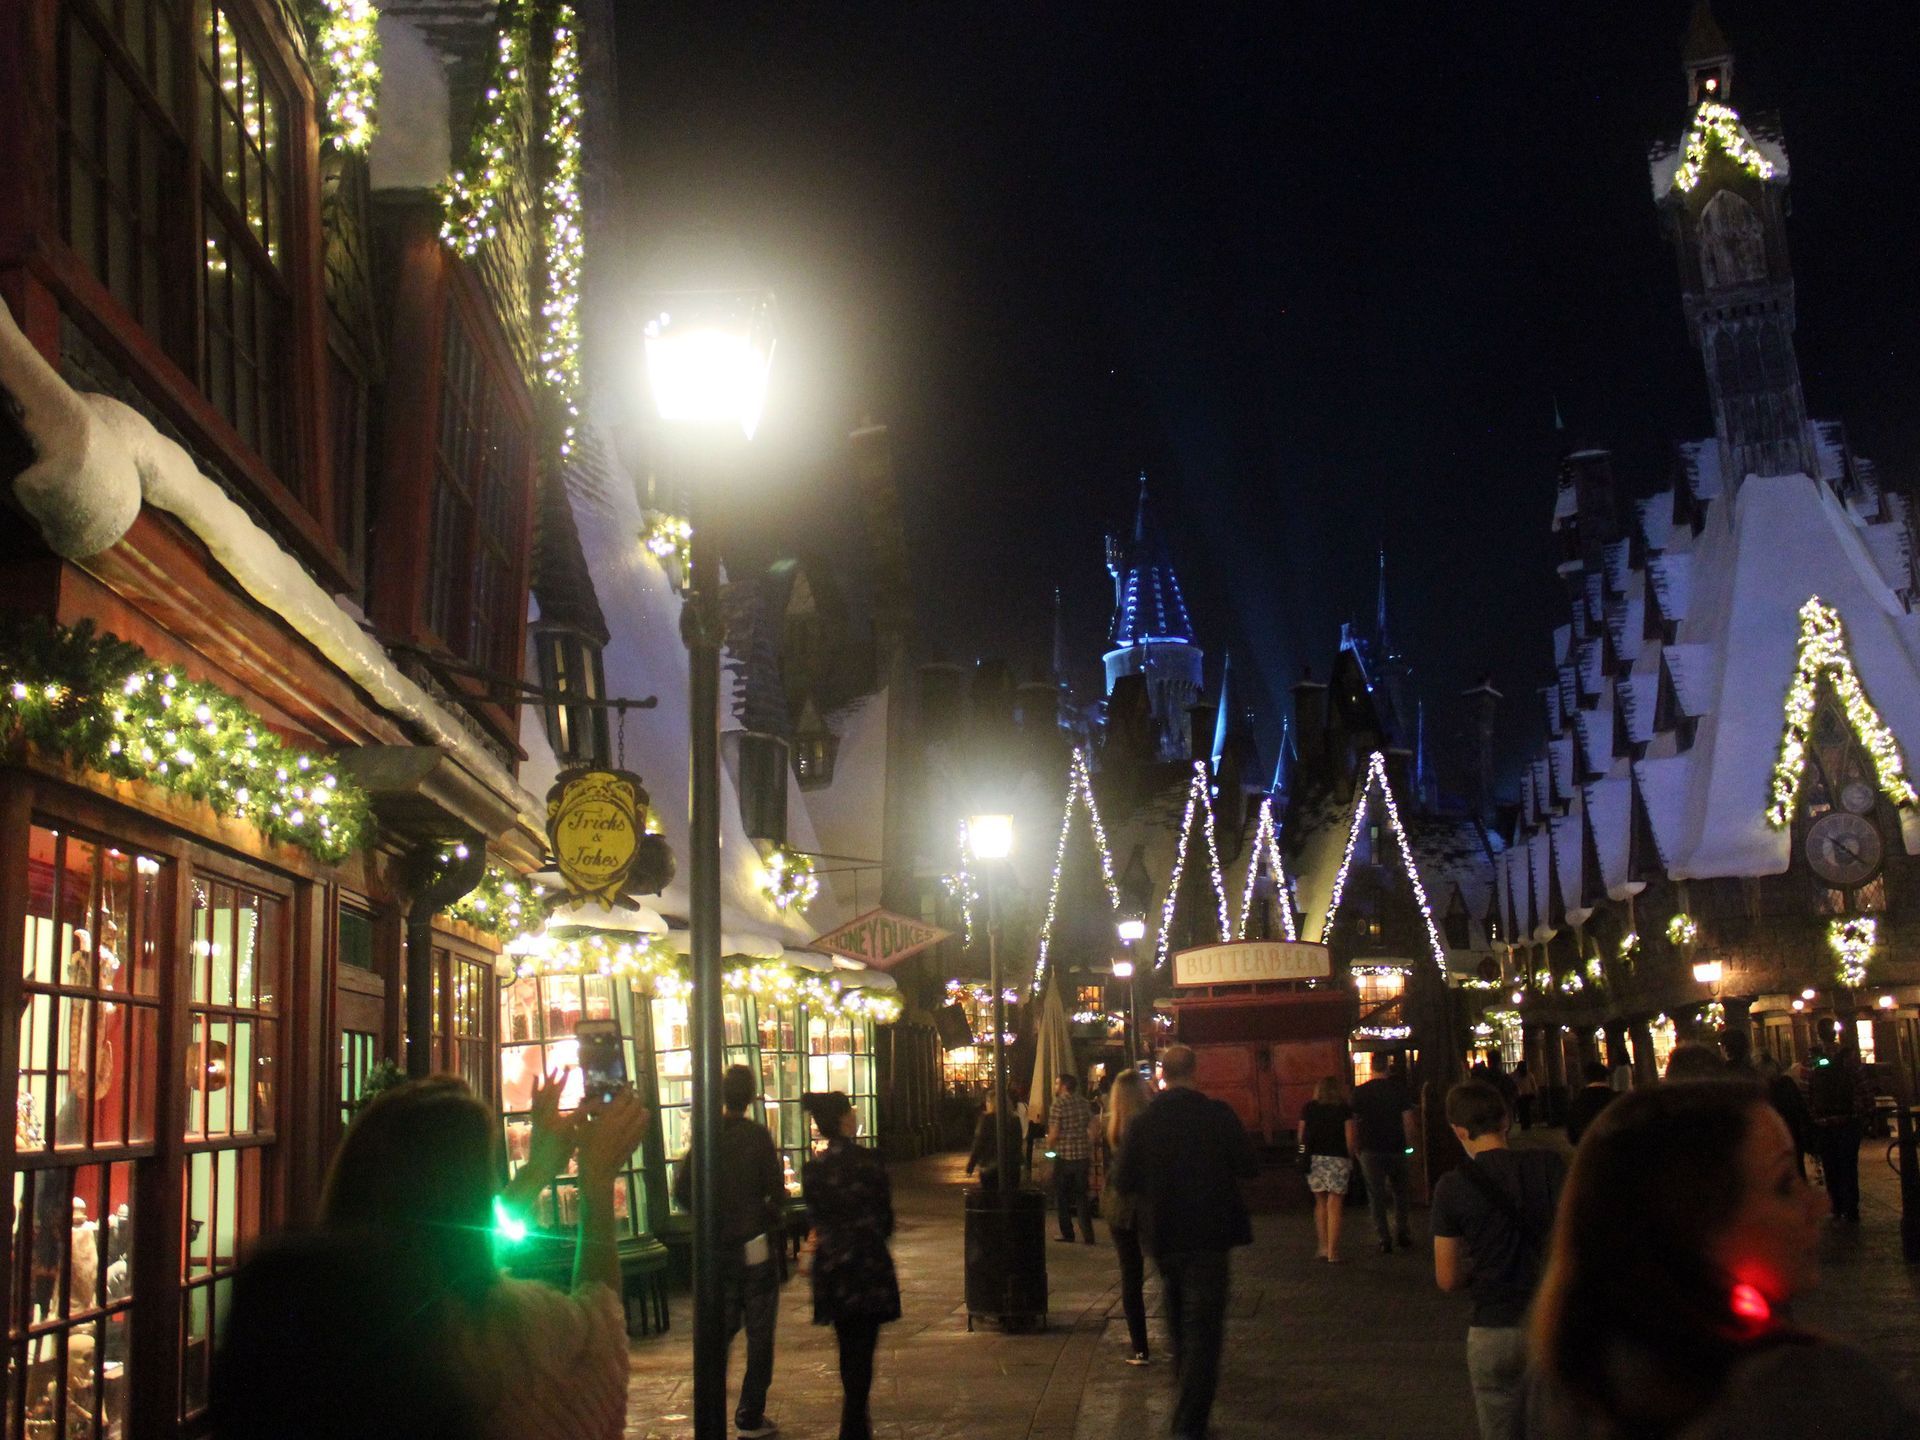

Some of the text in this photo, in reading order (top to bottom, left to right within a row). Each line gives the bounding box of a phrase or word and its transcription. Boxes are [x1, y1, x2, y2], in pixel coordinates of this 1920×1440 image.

[569, 810, 625, 831] Tricks
[593, 833, 602, 842] &
[569, 847, 619, 867] Jokes
[829, 917, 935, 959] HONEYDUKES
[1187, 949, 1321, 976] BUTTERBEER
